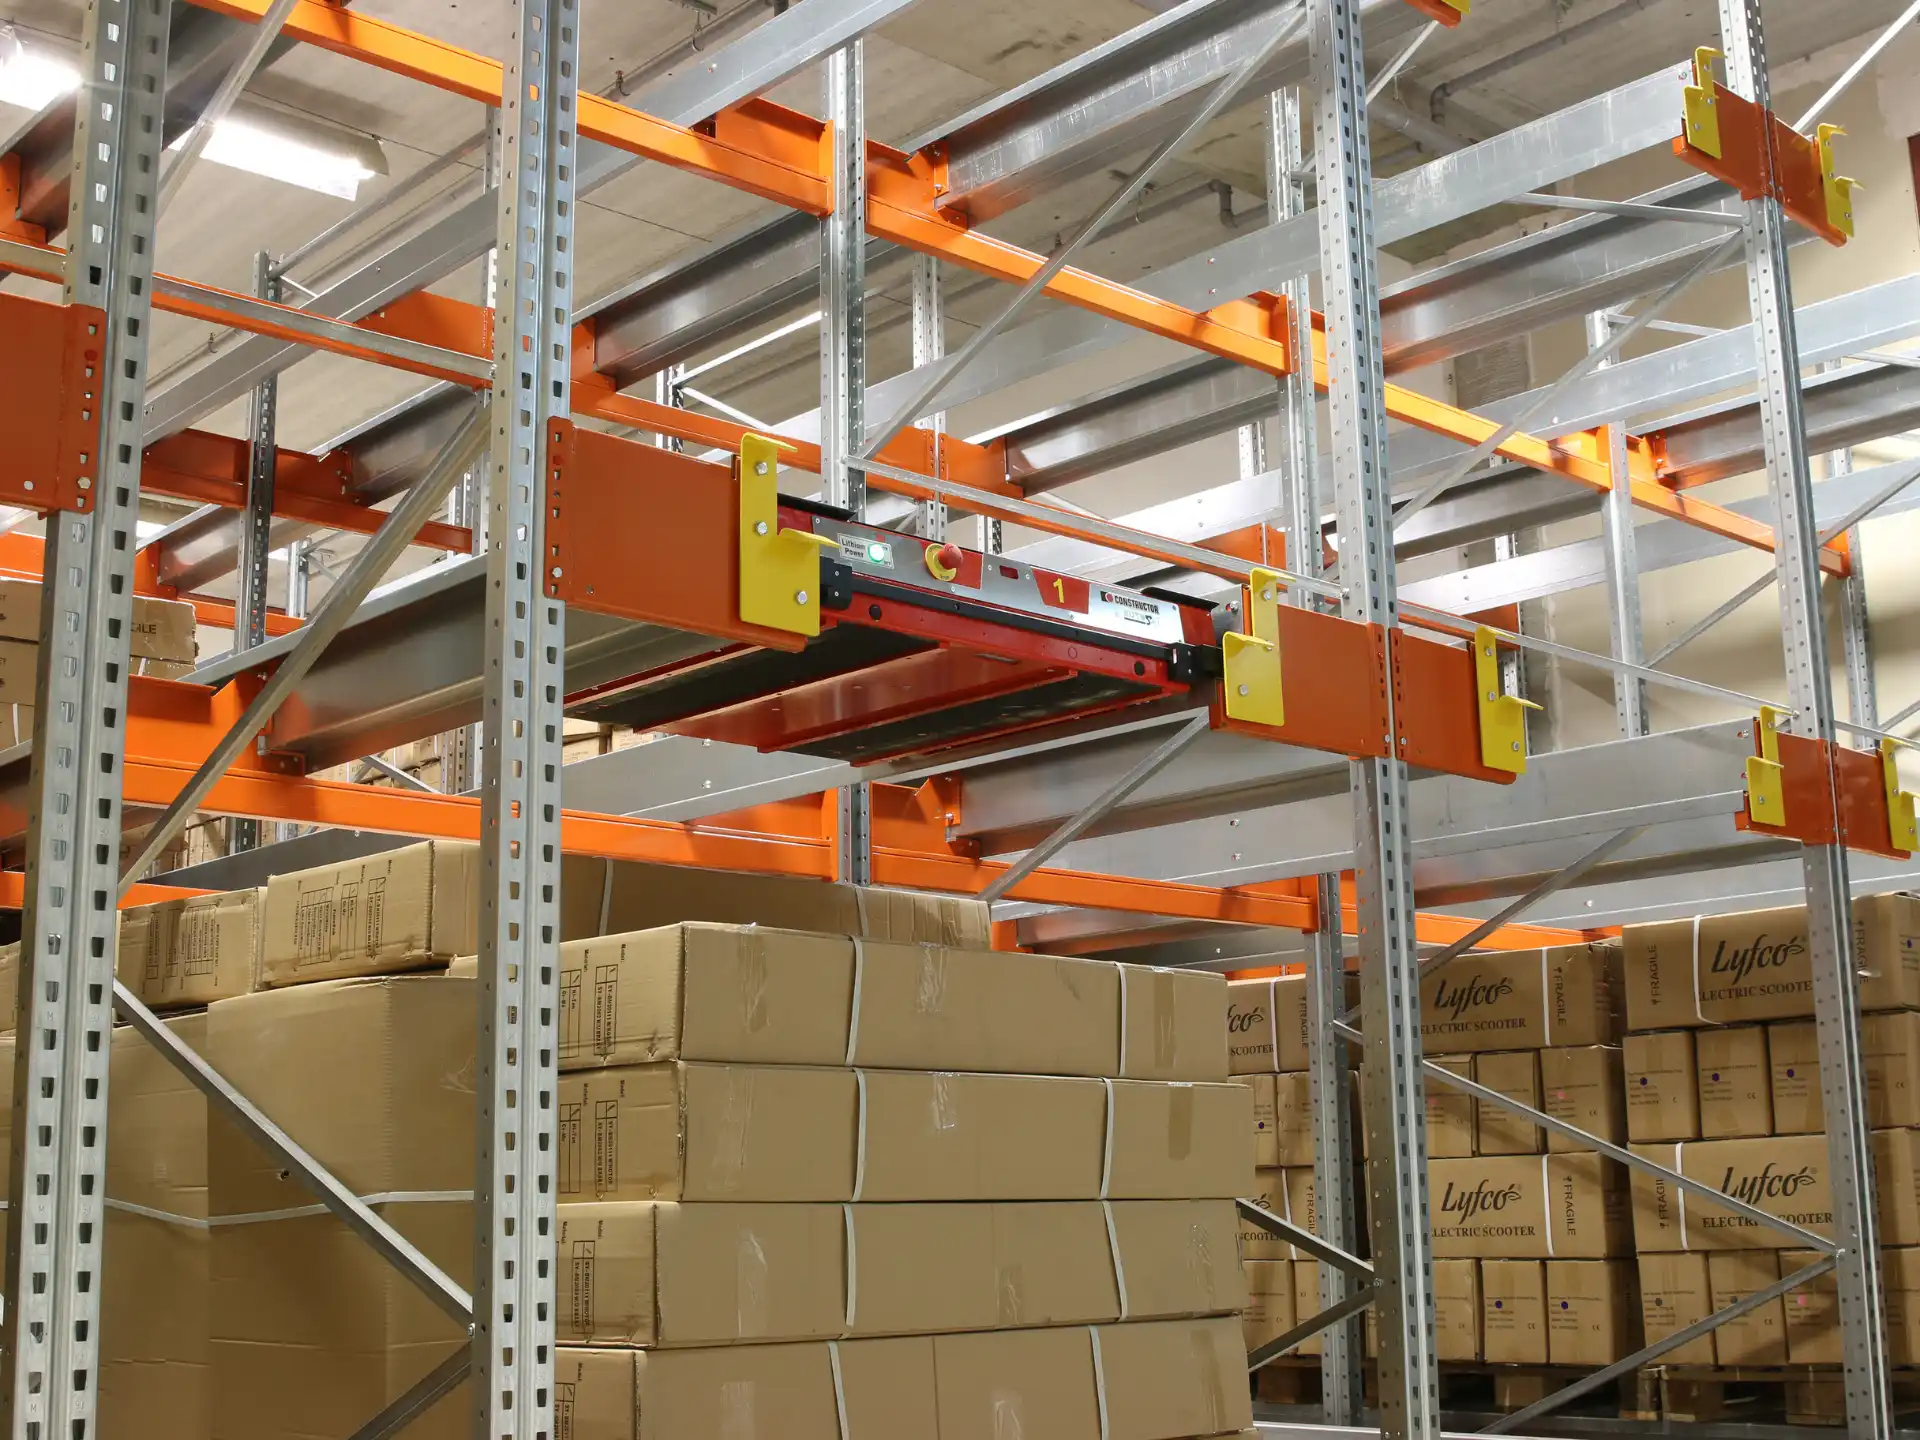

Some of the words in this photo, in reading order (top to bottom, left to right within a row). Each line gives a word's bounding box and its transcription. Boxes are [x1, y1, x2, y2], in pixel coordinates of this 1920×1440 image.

[841, 538, 866, 549] Lithium
[844, 547, 864, 558] Power
[1053, 578, 1064, 603] 1
[1114, 595, 1160, 614] CONSTRUCTOR
[131, 622, 157, 634] GILE
[1855, 928, 1869, 985] FRAGIE
[1649, 944, 1660, 996] FRAGILE
[1759, 980, 1813, 995] SCOOTE
[1554, 976, 1567, 1027] FRAGILE
[1299, 1003, 1310, 1049] FRAGILE
[1475, 1017, 1528, 1031] SCOOTER
[1563, 1184, 1576, 1236] FRAGILE
[1701, 1215, 1759, 1228] ELECTR
[1482, 1226, 1536, 1237] SCOOTER
